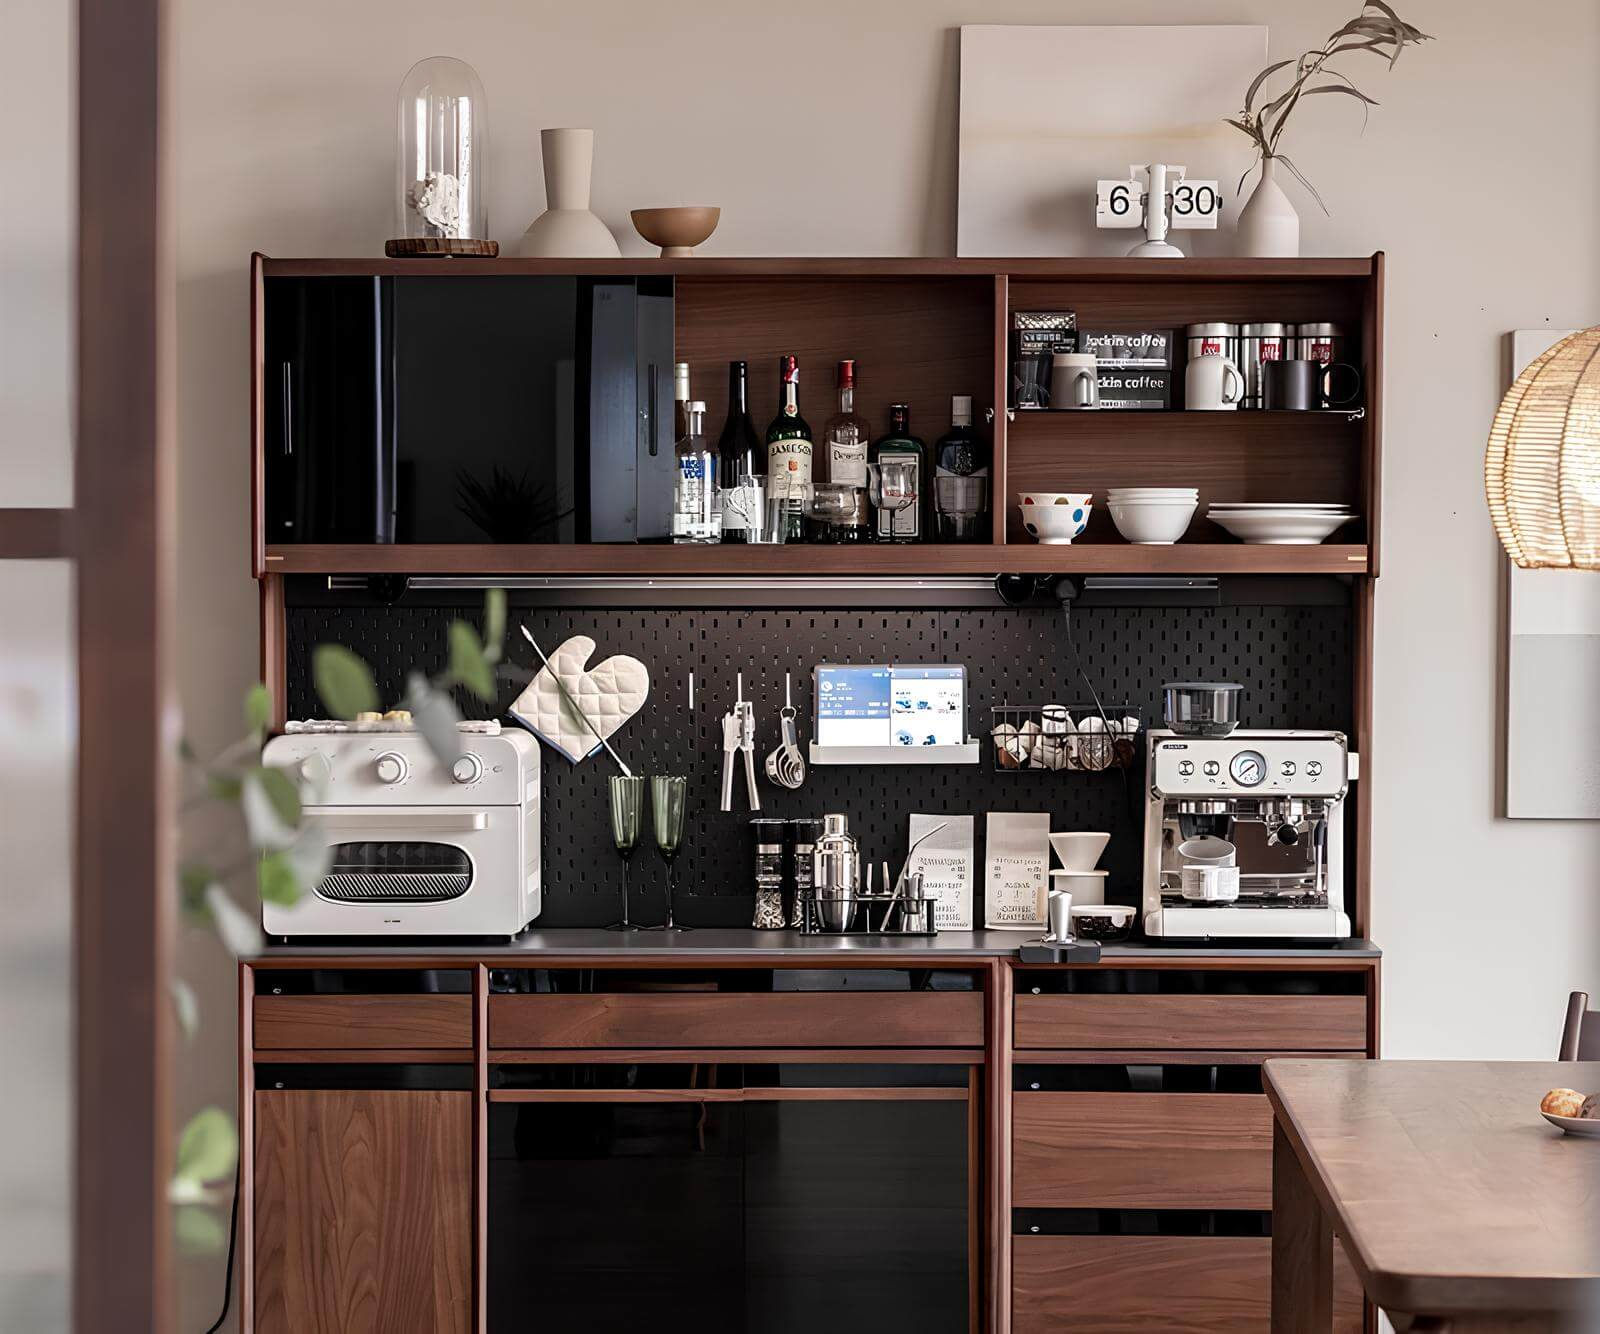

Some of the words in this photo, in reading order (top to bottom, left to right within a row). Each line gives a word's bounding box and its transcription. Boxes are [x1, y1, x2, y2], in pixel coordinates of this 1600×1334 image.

[1110, 185, 1130, 215] 6
[1174, 186, 1216, 215] 30
[1127, 333, 1167, 348] coffee
[1125, 375, 1165, 389] coffee
